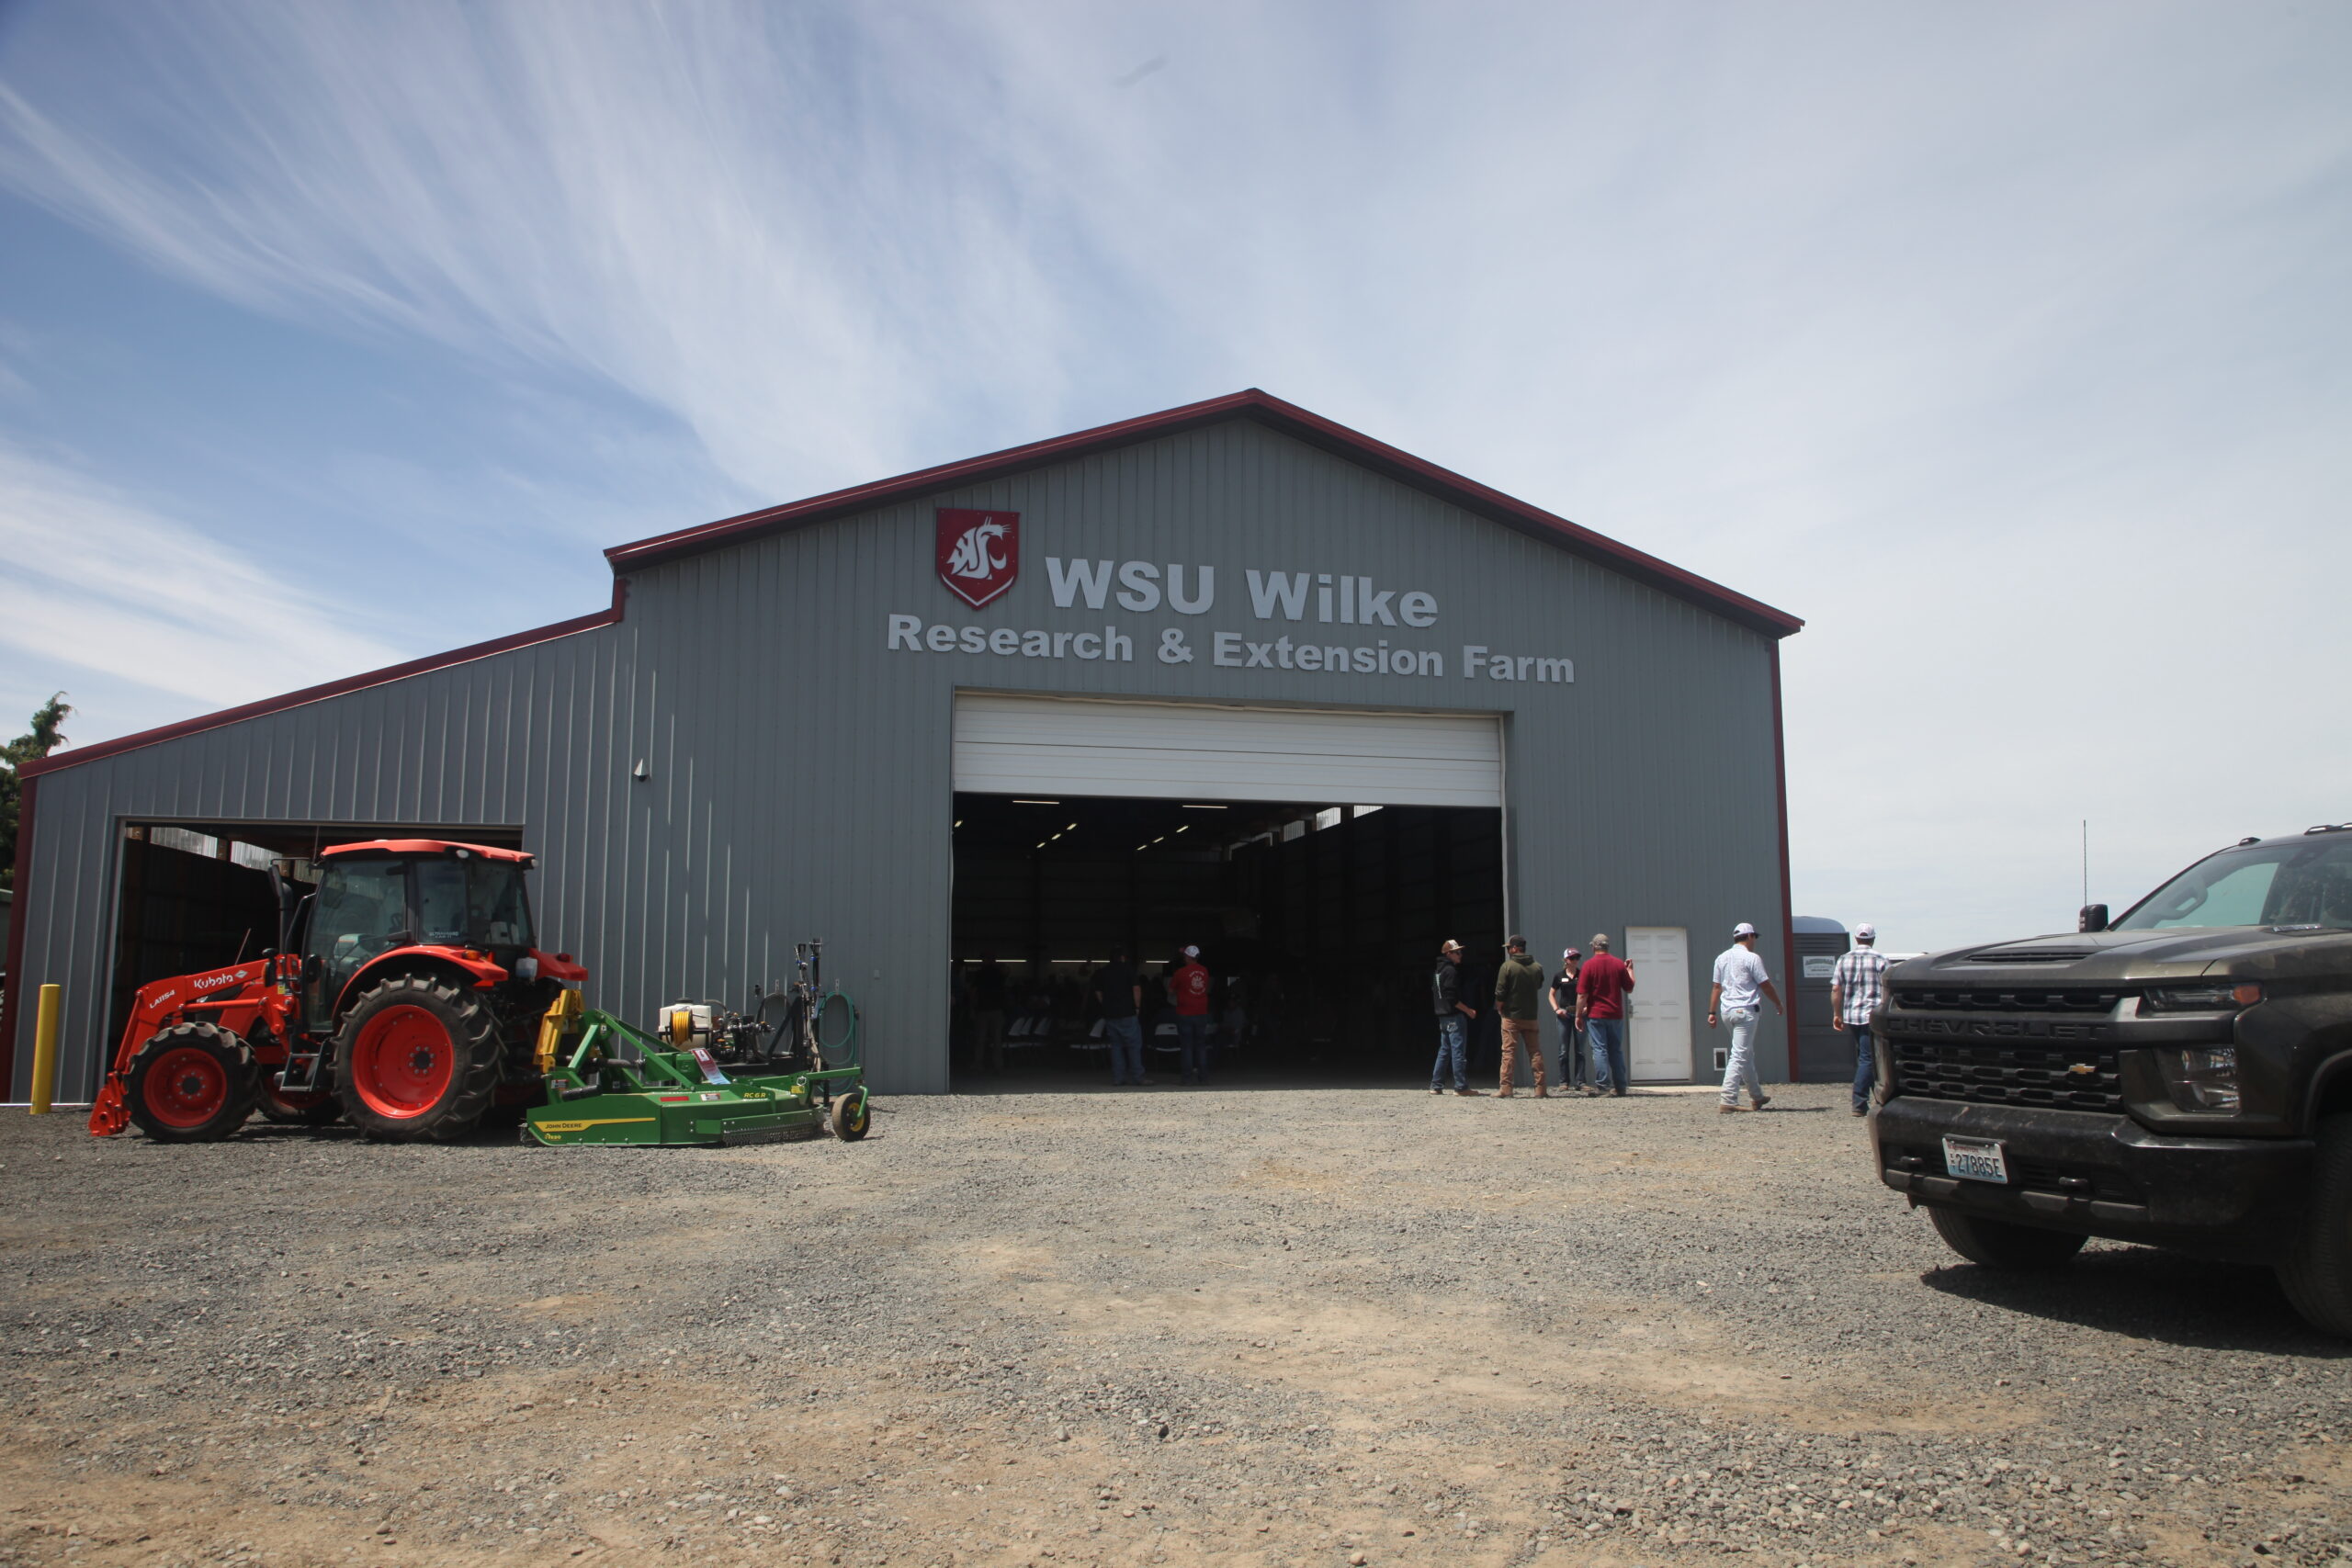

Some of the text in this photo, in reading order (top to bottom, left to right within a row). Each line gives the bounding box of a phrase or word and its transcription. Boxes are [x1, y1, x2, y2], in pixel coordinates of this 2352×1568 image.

[1045, 557, 1439, 627] WSU Wilke
[888, 613, 1575, 683] Research & Extension Farm
[194, 974, 234, 989] Kubota
[1886, 1017, 2109, 1040] CHEVROLET
[1955, 1153, 2003, 1178] 27885E
